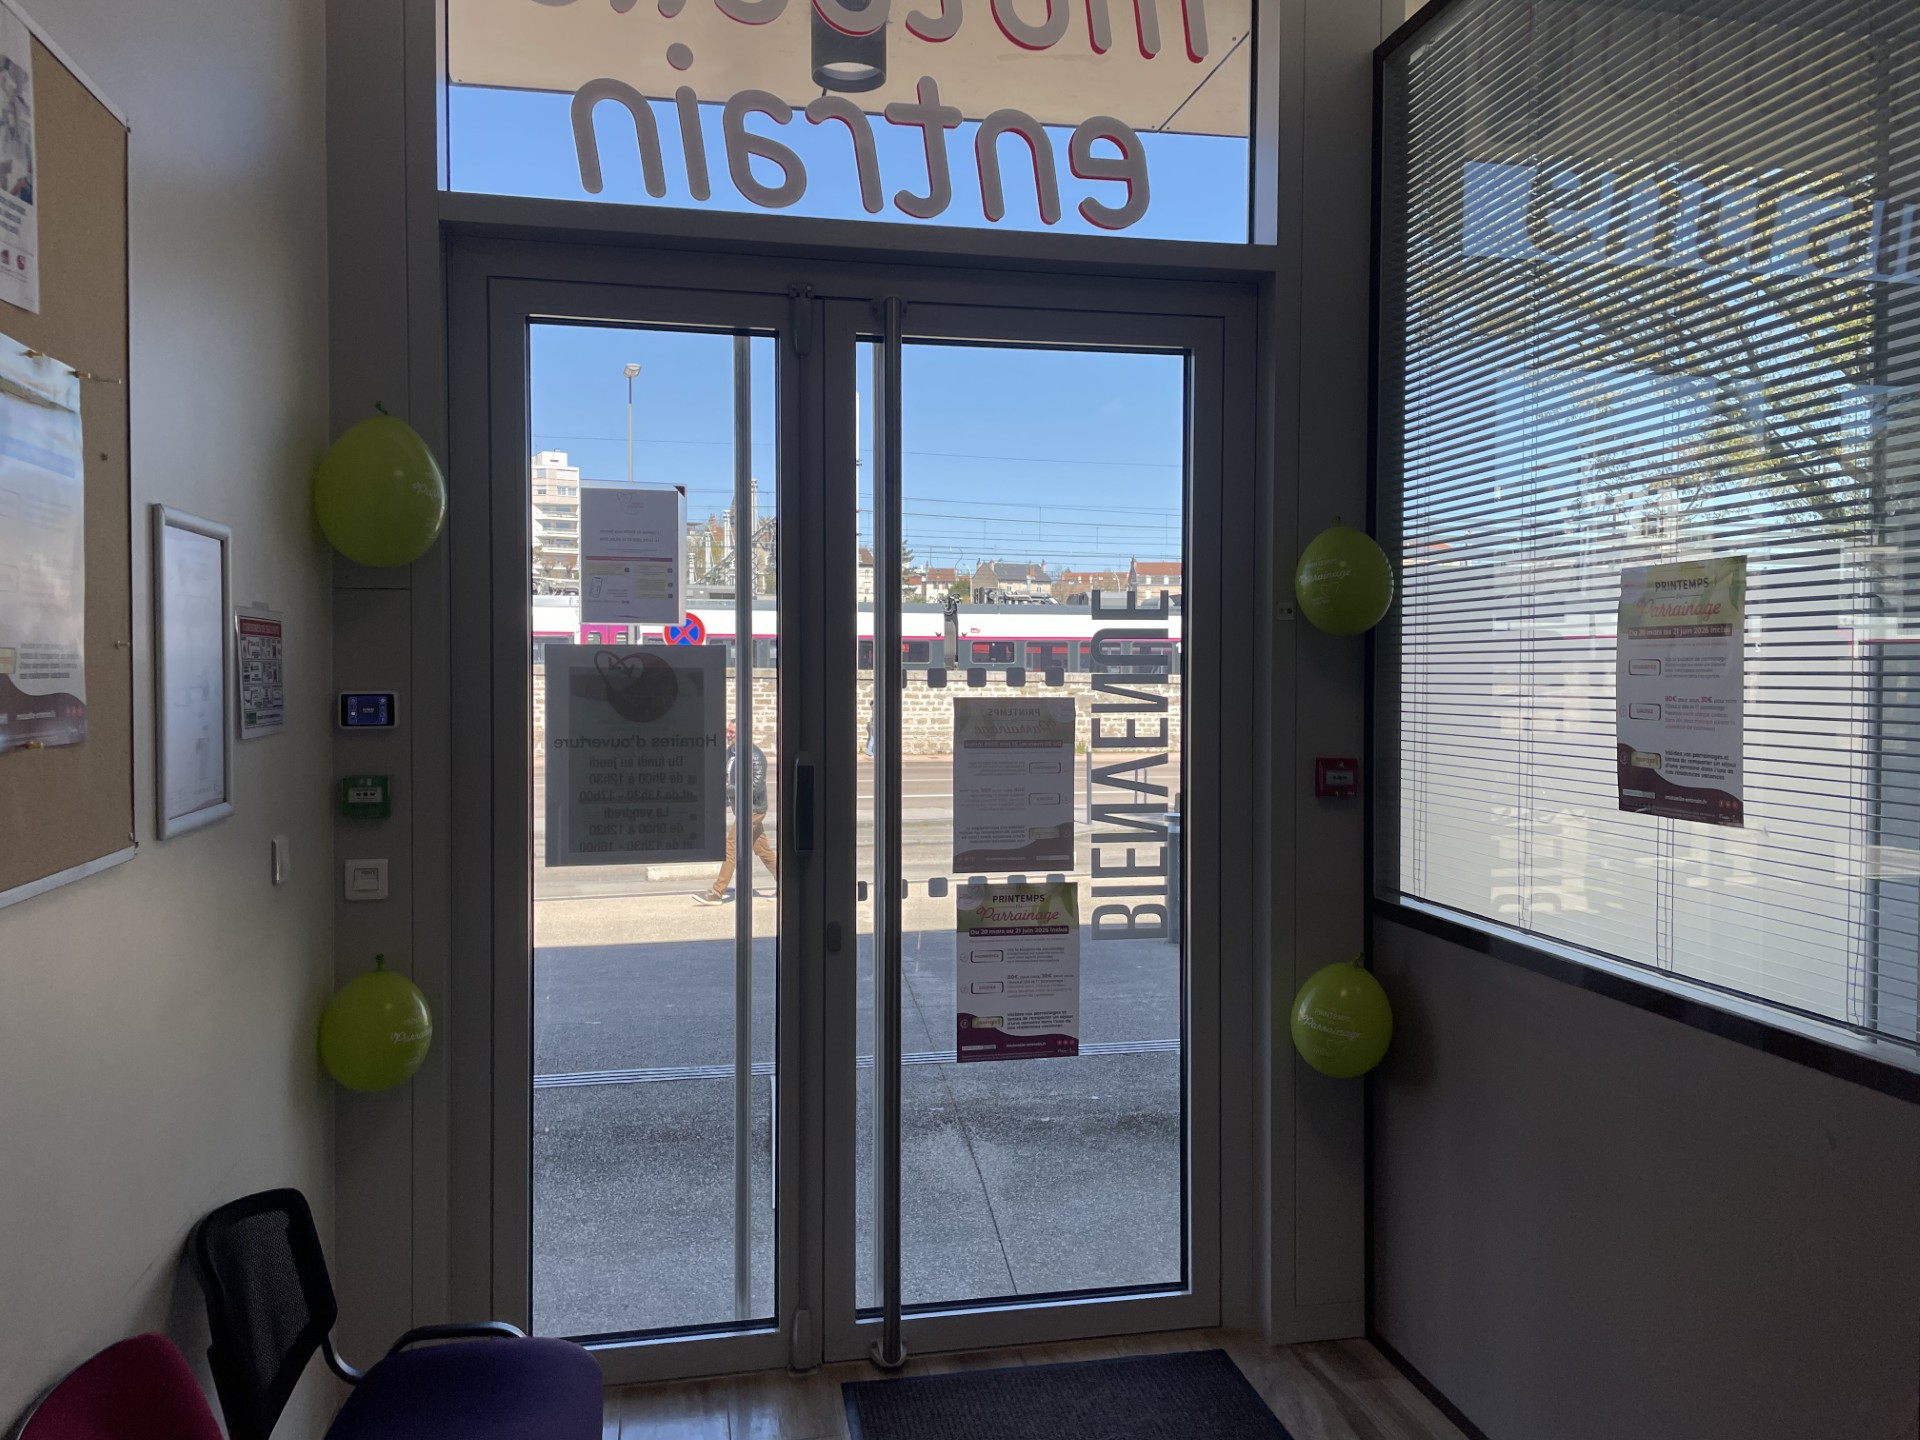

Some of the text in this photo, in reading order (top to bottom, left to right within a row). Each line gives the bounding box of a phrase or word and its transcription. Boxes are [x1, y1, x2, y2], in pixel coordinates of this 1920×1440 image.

[1655, 577, 1710, 593] PRINTEMPS
[1636, 598, 1722, 622] Parrainage
[992, 894, 1045, 903] PRINTEMPS
[976, 906, 1059, 925] Parrainage
